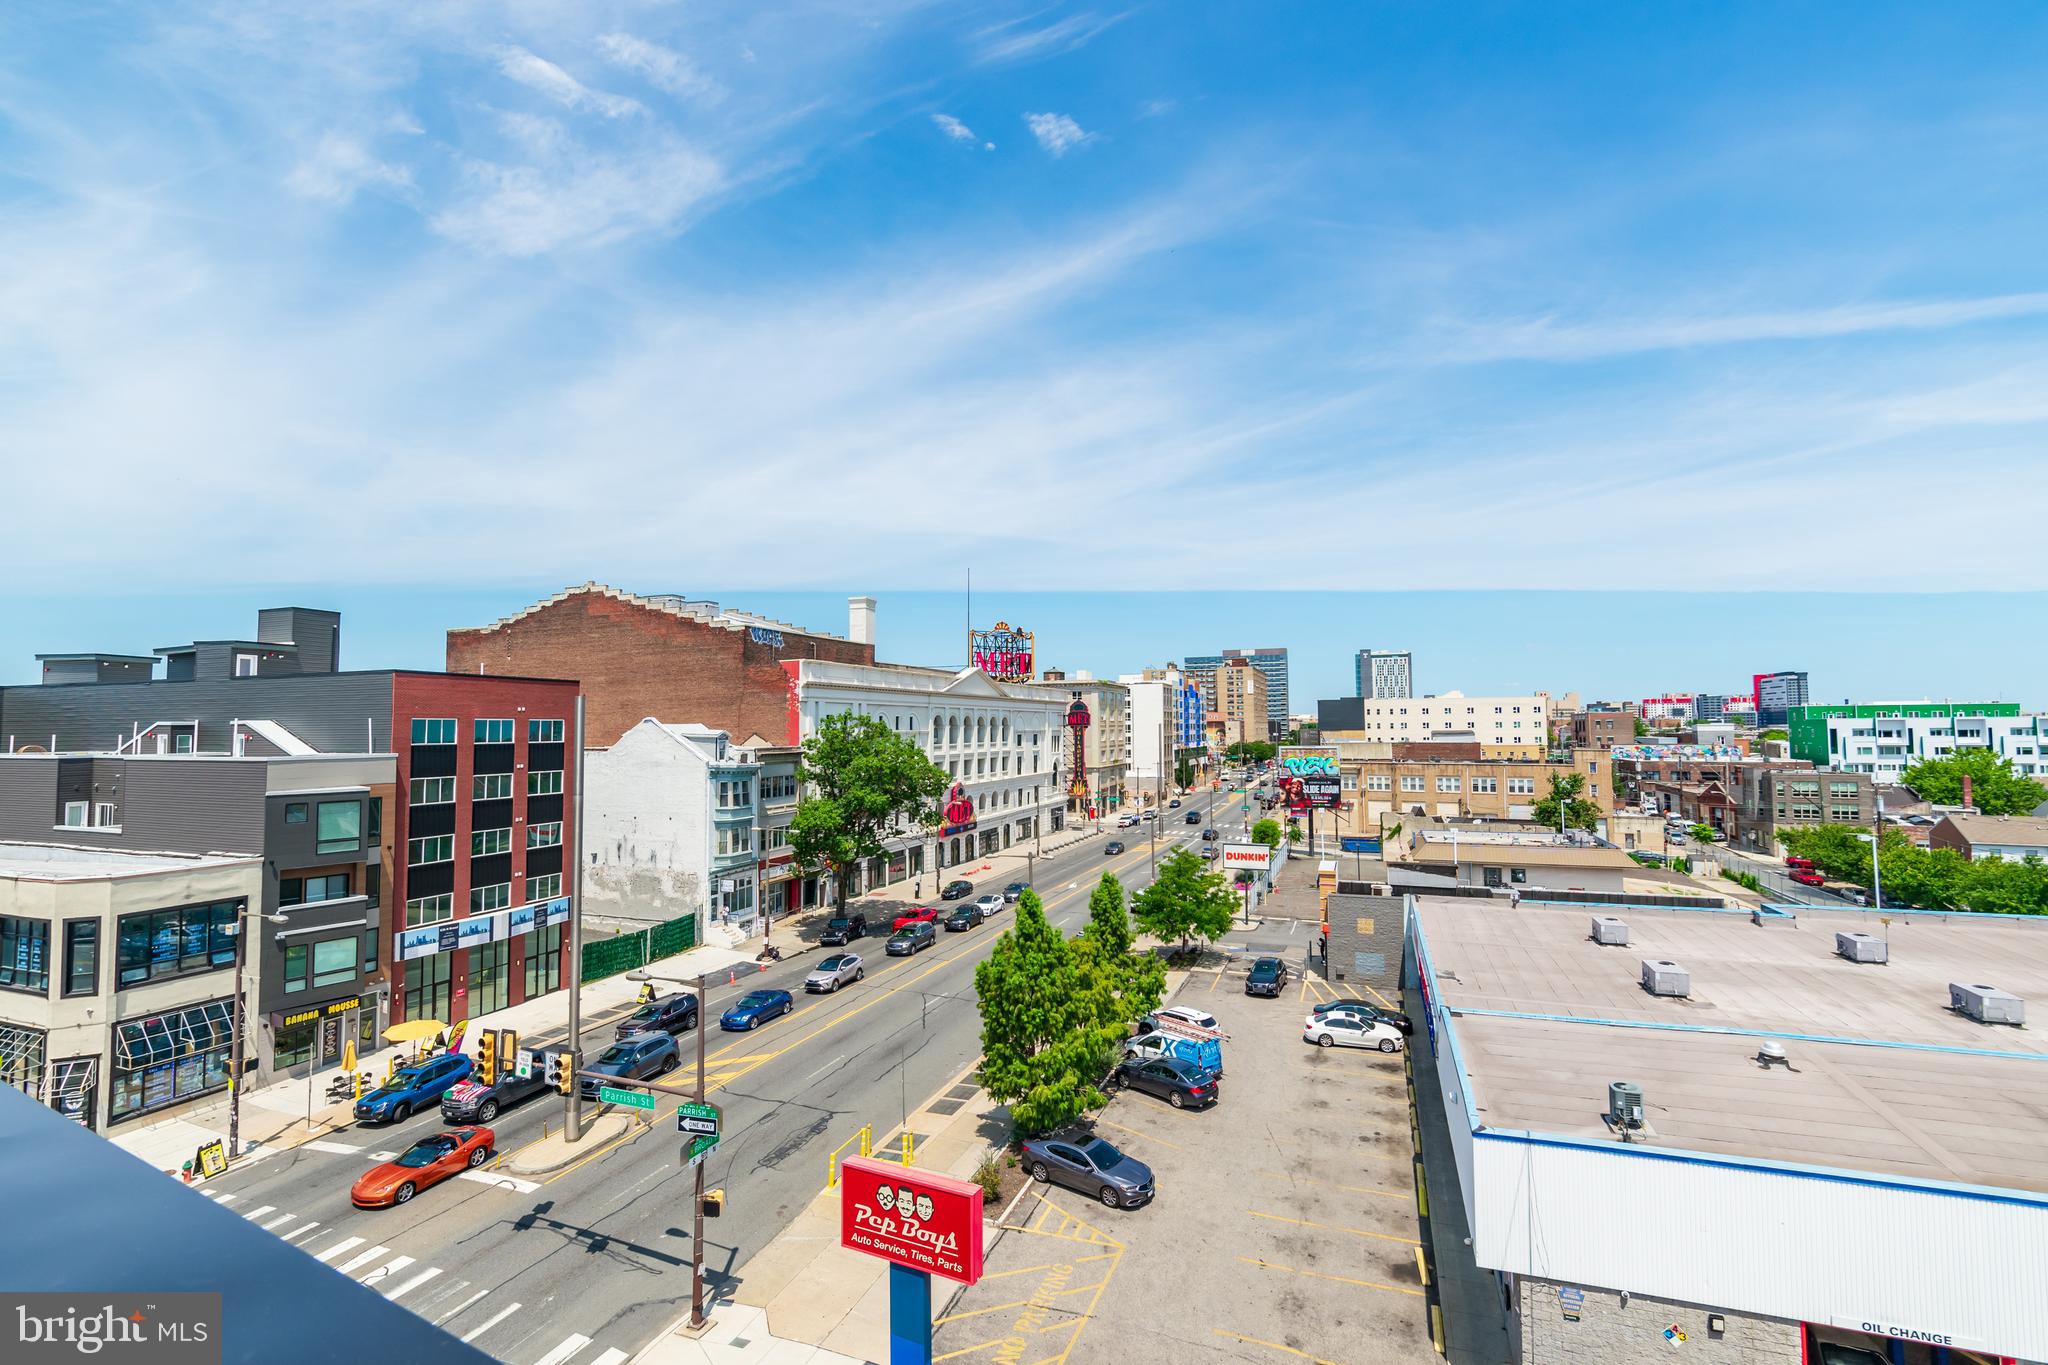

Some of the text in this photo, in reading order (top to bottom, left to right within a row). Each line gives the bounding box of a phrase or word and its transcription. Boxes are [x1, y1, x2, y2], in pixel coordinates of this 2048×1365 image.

[975, 651, 1032, 675] MET
[1303, 785, 1340, 794] SLIDE AGAIN
[1225, 851, 1269, 862] DUNKIN'
[285, 998, 360, 1026] BANANA MOUSSE
[605, 1090, 650, 1107] Parrish St
[678, 1107, 707, 1117] PARRISH
[701, 1122, 713, 1130] WAY
[854, 1203, 959, 1254] Pep Boys
[851, 1231, 963, 1273] Auto Service, Tires, Parts
[1664, 1329, 1687, 1342] 3 3
[1671, 1323, 1679, 1333] 4
[1861, 1322, 1952, 1345] OIL CHANGE
